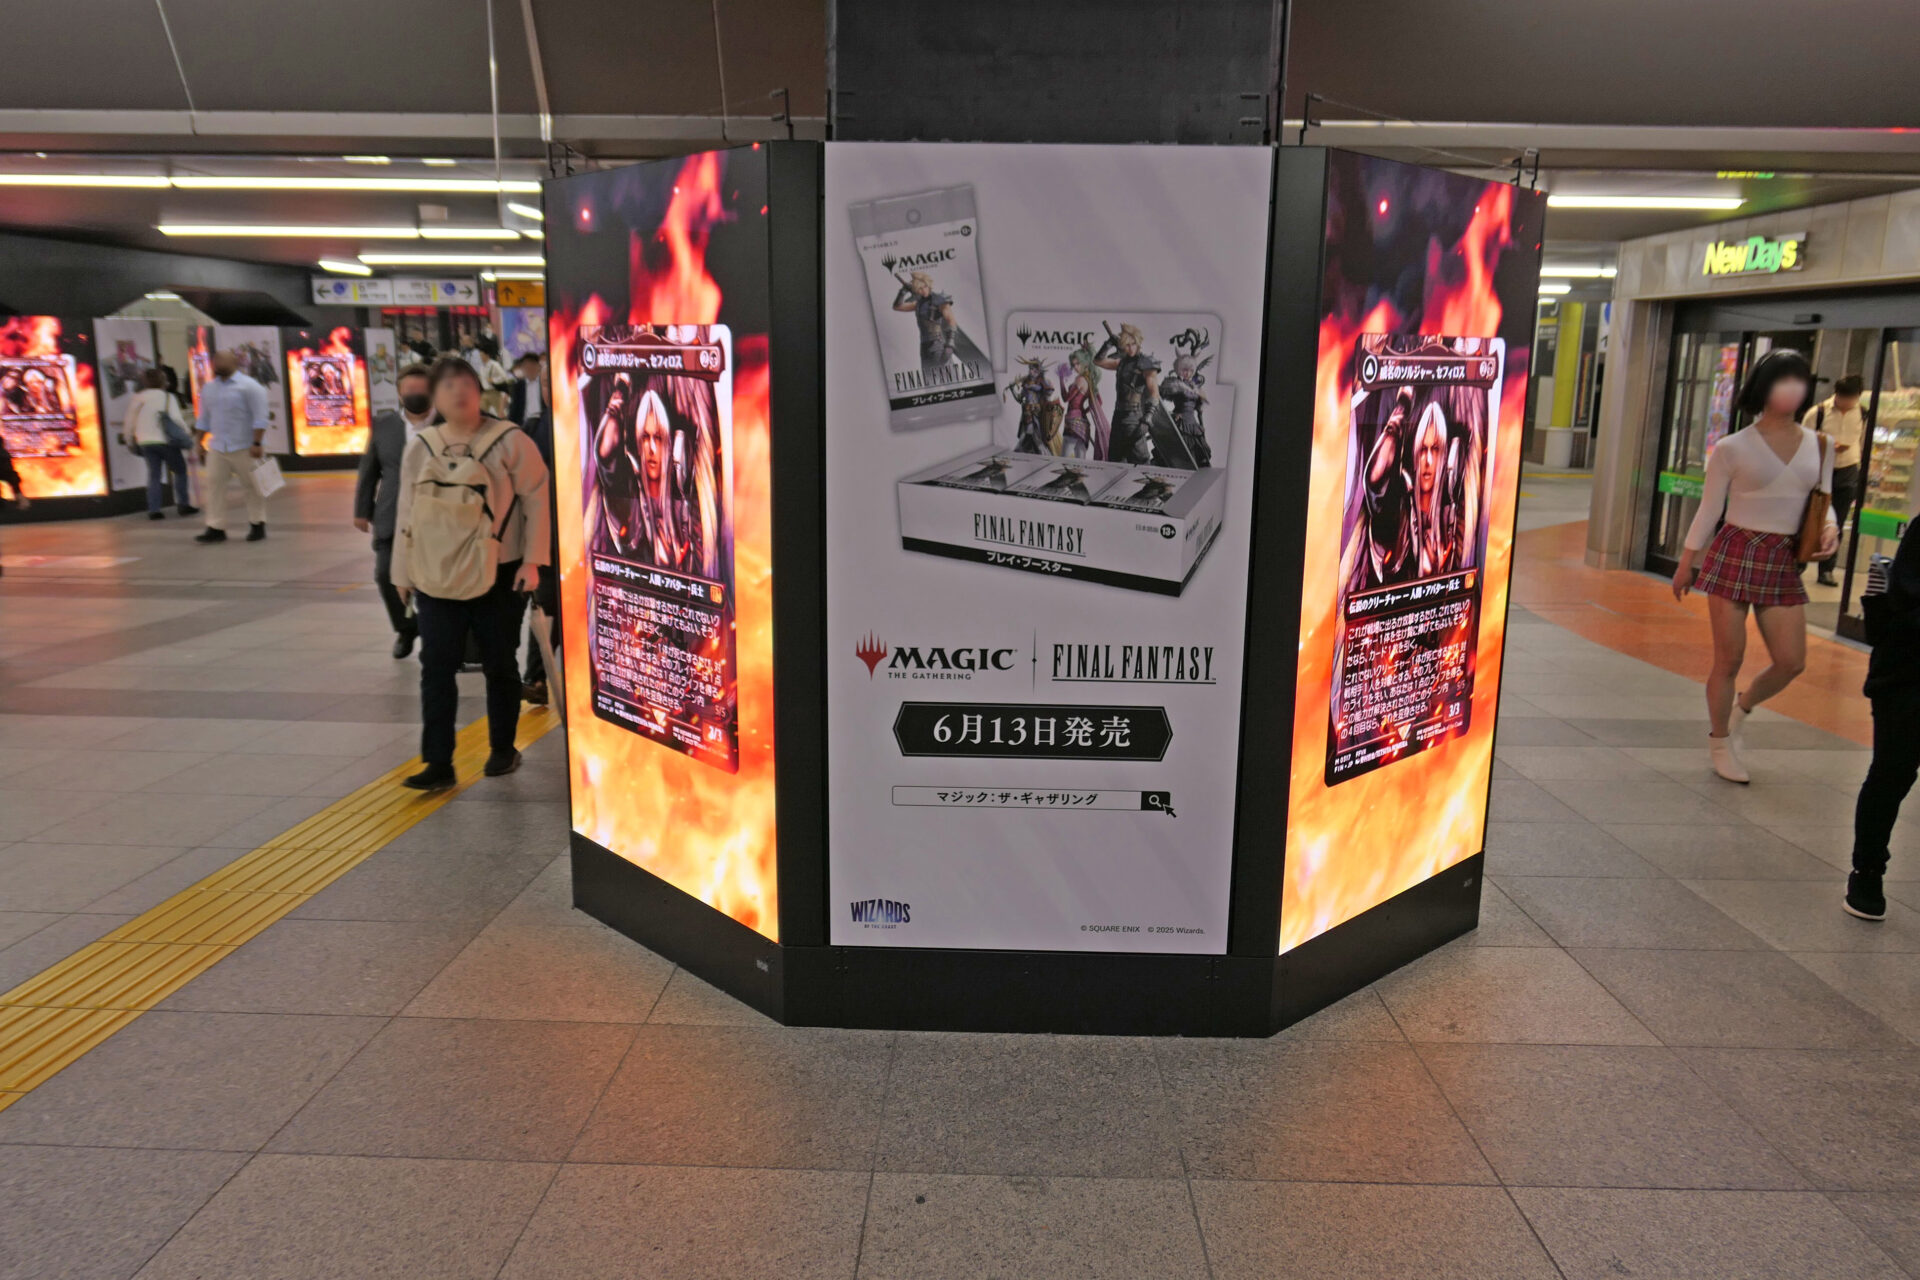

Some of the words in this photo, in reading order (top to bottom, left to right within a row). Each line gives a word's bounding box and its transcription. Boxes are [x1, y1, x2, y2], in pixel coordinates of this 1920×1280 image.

[898, 248, 957, 269] MAGIC
[1702, 235, 1797, 276] NewDays
[1032, 330, 1095, 346] MAGIC
[894, 367, 928, 392] FINAL
[932, 360, 981, 385] FANTASY
[912, 389, 974, 405] プレイ・ブースター
[974, 513, 1015, 543] FINAL
[1019, 519, 1084, 553] FANTASY
[1161, 527, 1175, 536] 13+
[986, 551, 1073, 573] プレイ・ブースター
[888, 647, 1015, 673] MAGIC
[1052, 643, 1115, 680] FINAL
[1121, 645, 1214, 681] FANTASY
[888, 672, 909, 680] THE
[912, 672, 972, 681] GATHERING
[1448, 702, 1461, 718] 3/3
[933, 713, 1132, 749] 6月13日発売
[936, 790, 1099, 806] マジック：ザ・ギャザリング
[850, 898, 911, 923] WIZARDS
[1089, 925, 1120, 933] SQUARE
[1122, 925, 1141, 933] ENIX
